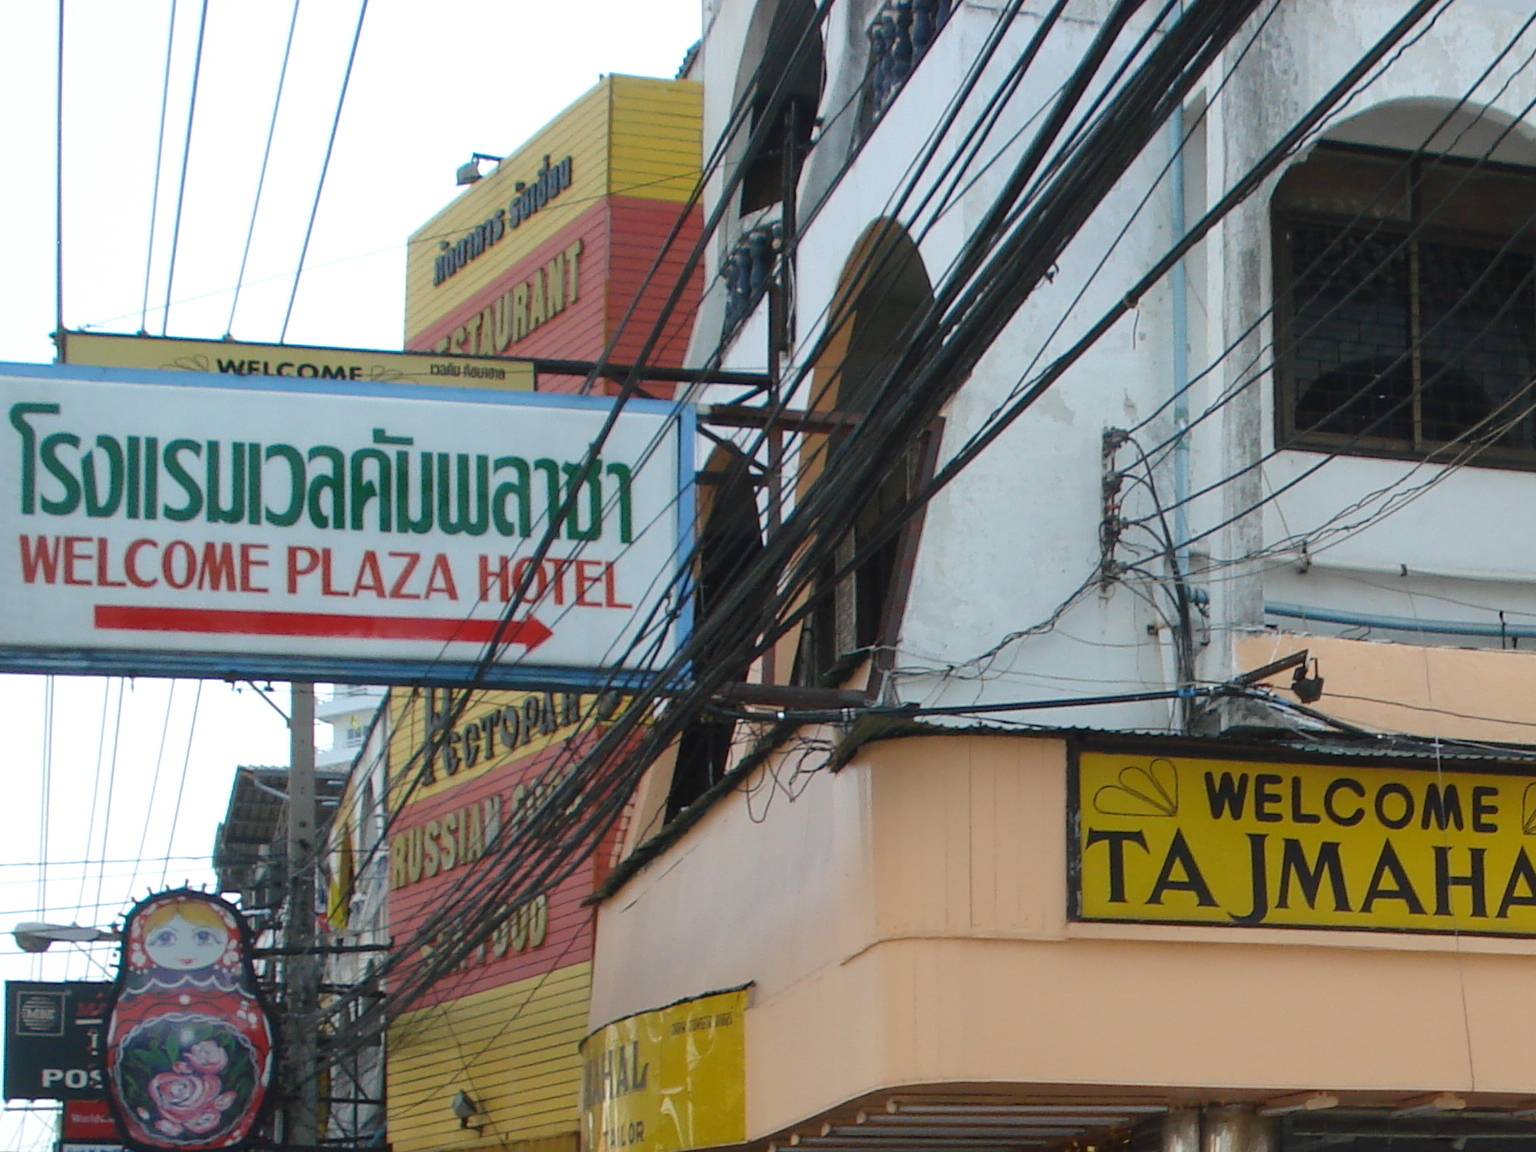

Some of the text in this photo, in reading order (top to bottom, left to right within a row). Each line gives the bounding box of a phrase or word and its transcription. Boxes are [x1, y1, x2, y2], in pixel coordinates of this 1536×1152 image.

[425, 238, 585, 355] STAURANT
[216, 356, 364, 381] WELCOME
[19, 535, 634, 610] WELCOME PLAZA HOTEL
[1204, 770, 1500, 834] WELCOME
[389, 793, 502, 890] RUSSIAN
